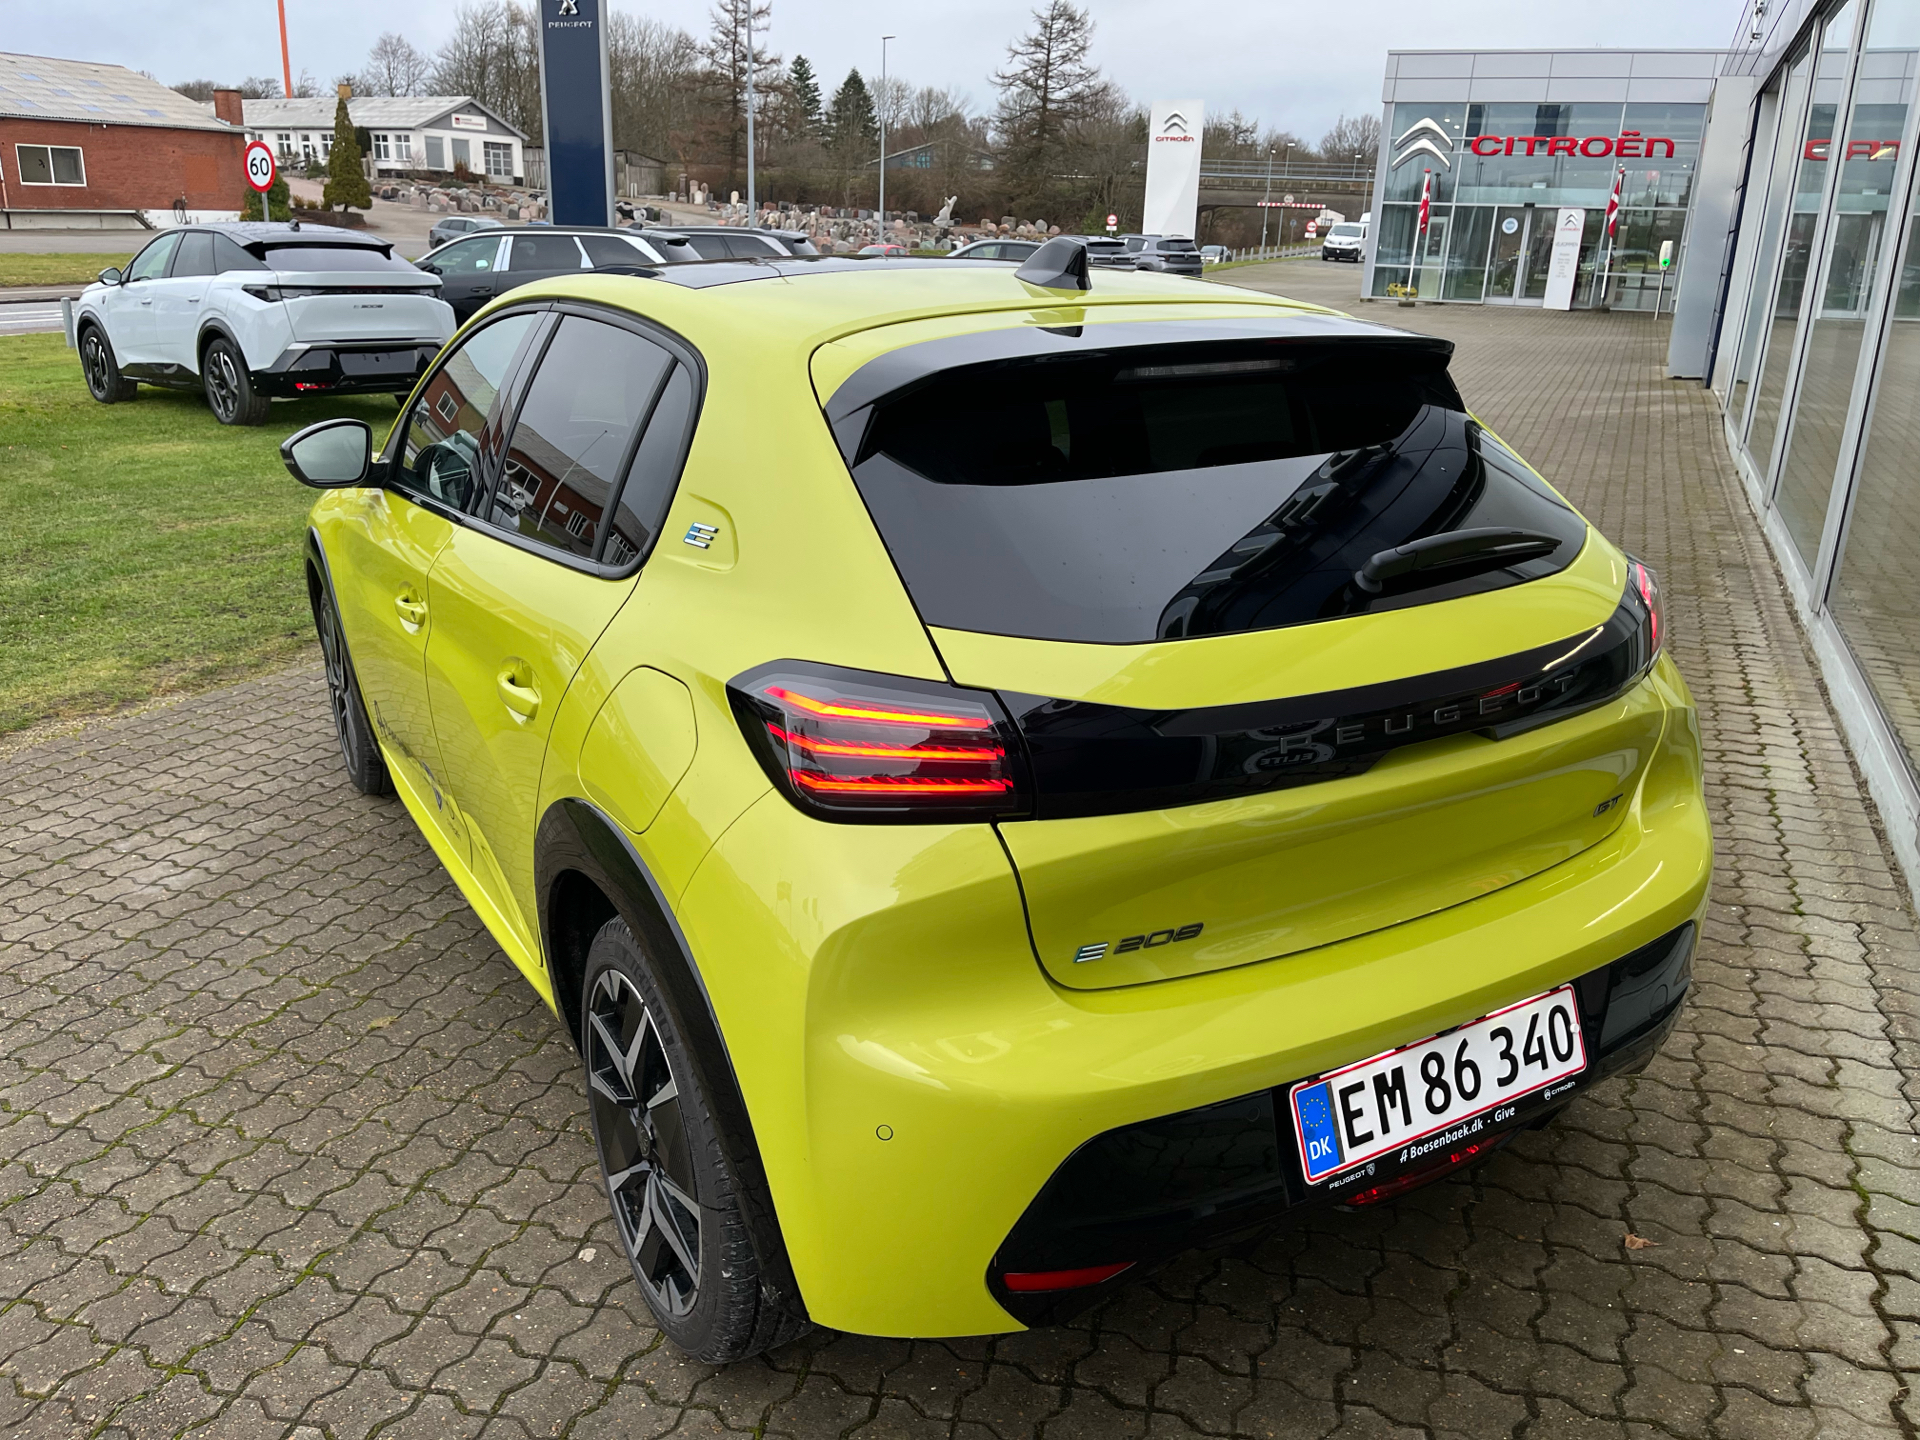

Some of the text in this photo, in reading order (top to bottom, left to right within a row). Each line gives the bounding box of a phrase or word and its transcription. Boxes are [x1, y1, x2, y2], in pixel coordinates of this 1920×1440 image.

[548, 20, 593, 29] PEUGEOT
[1155, 134, 1195, 142] CITROËN
[1471, 130, 1675, 159] CITROËN
[250, 157, 270, 176] 60
[1280, 674, 1574, 754] PEUGEOT
[1593, 793, 1623, 818] GT
[1113, 922, 1204, 954] 208
[624, 952, 674, 1040] MICHELIN
[1339, 1005, 1574, 1150] EM 86 340
[1551, 1081, 1576, 1096] CITROËN
[1410, 1118, 1484, 1159] Boesenbaek.dk
[1494, 1106, 1515, 1123] Give
[1309, 1136, 1332, 1160] DK
[1329, 1170, 1366, 1190] PEUGEOT
